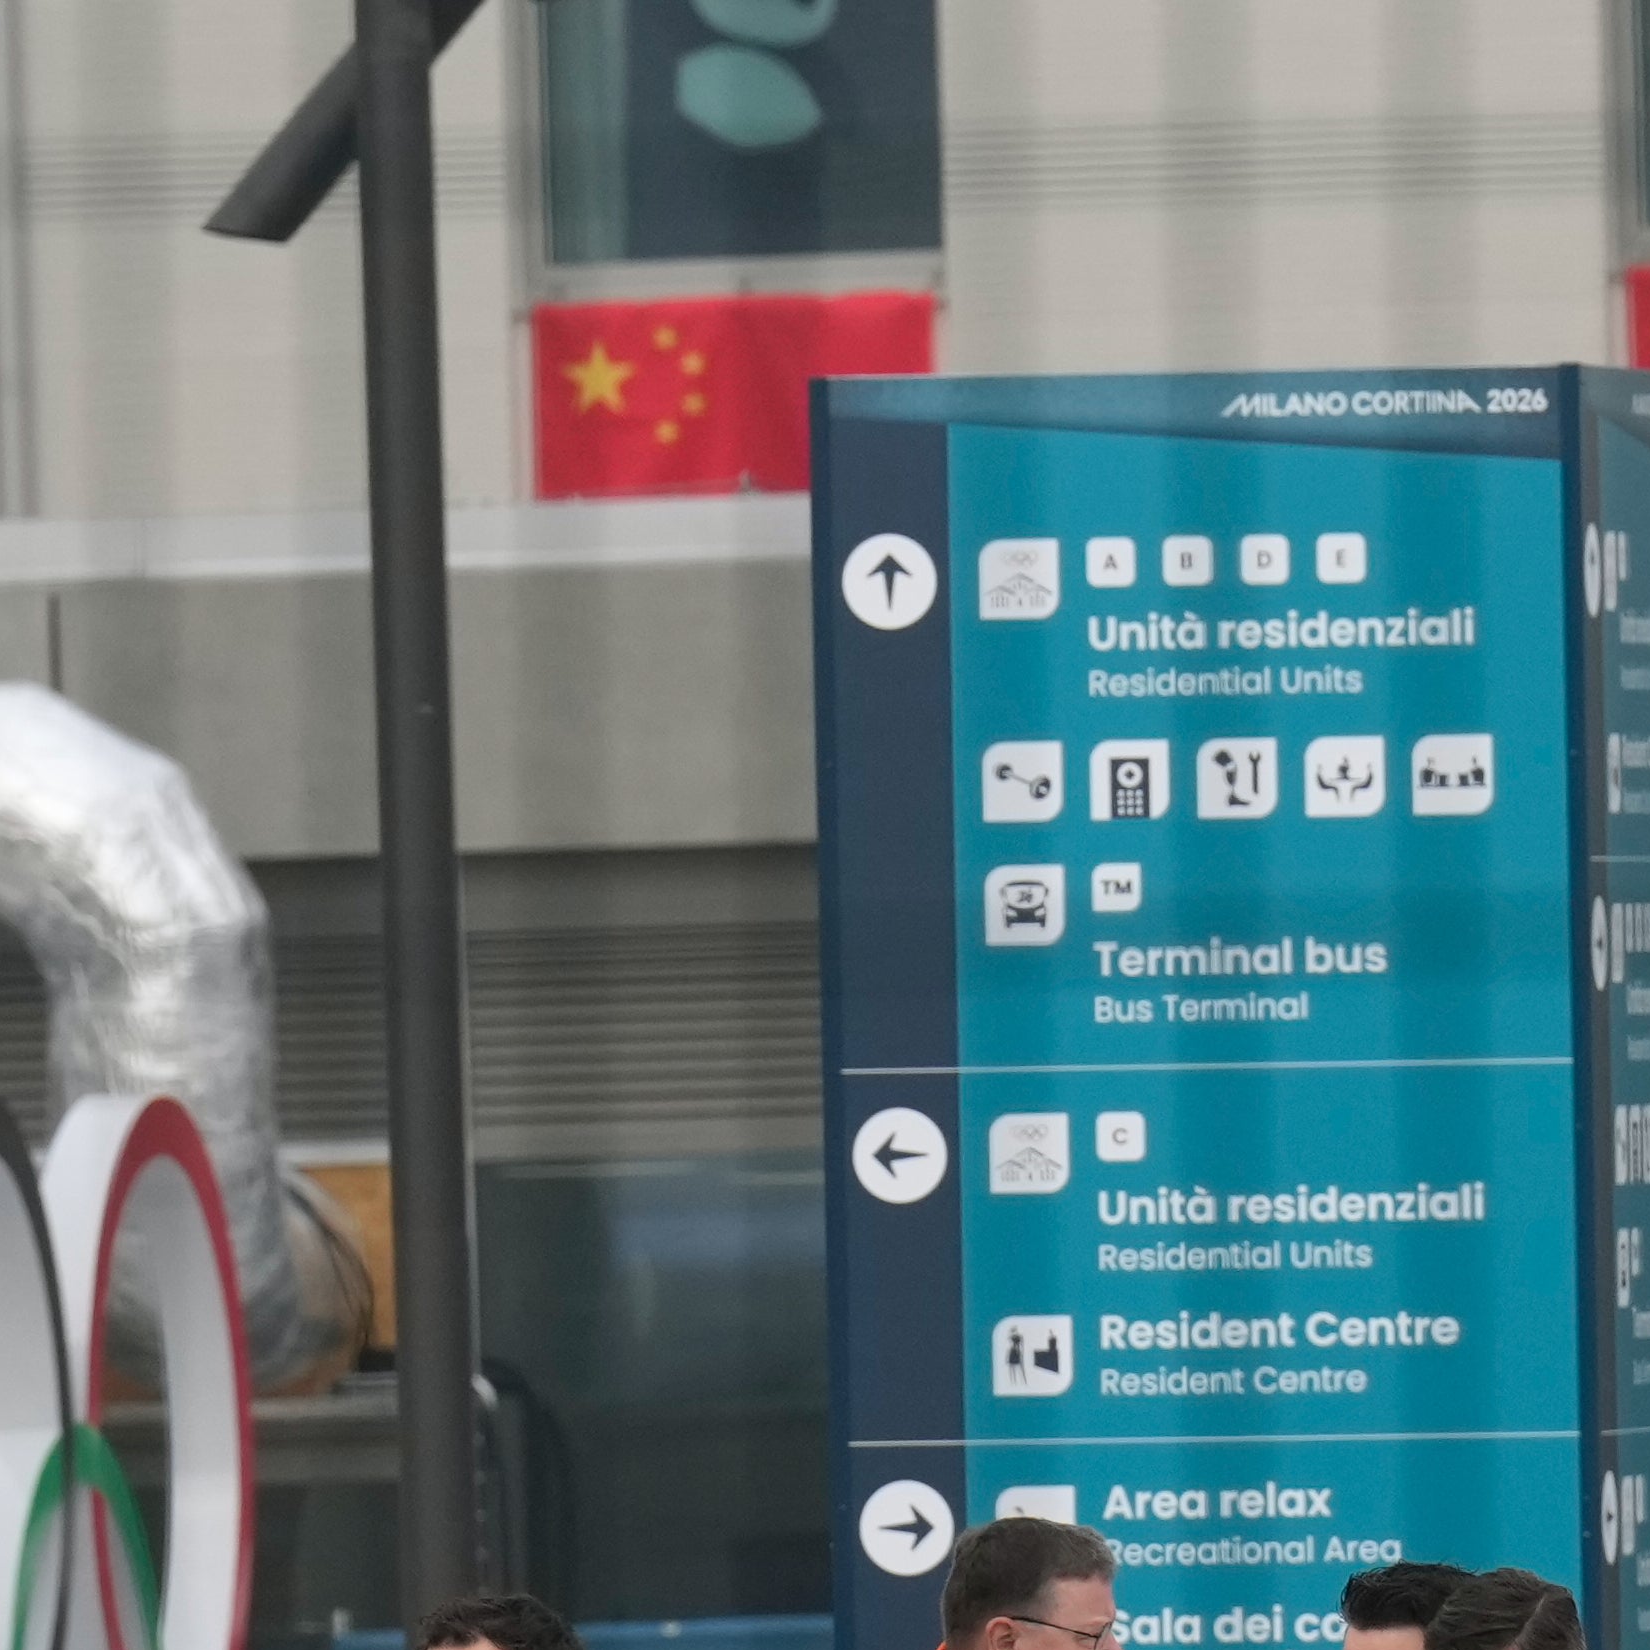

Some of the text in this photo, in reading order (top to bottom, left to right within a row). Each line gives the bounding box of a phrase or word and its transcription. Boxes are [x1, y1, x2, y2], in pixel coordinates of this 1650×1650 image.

[1222, 387, 1547, 417] MILANO CORTINA 2026
[1103, 550, 1347, 571] A B D E
[1088, 605, 1476, 651] Unità residenziali
[1088, 664, 1364, 695] Residential Units
[1102, 880, 1133, 896] TM
[1094, 937, 1389, 975] Terminal bus
[1094, 991, 1310, 1022] Bus Terminal
[1113, 1129, 1128, 1145] C
[1097, 1179, 1485, 1225] Unità residenziali
[1098, 1239, 1373, 1270] Residential Units
[1099, 1309, 1461, 1349] Resident Centre
[1099, 1364, 1368, 1395] Resident Centre
[1105, 1480, 1333, 1519] Area relax
[1106, 1534, 1402, 1565] Recreational Area
[1112, 1606, 1202, 1644] Sala
[1213, 1602, 1283, 1641] dei
